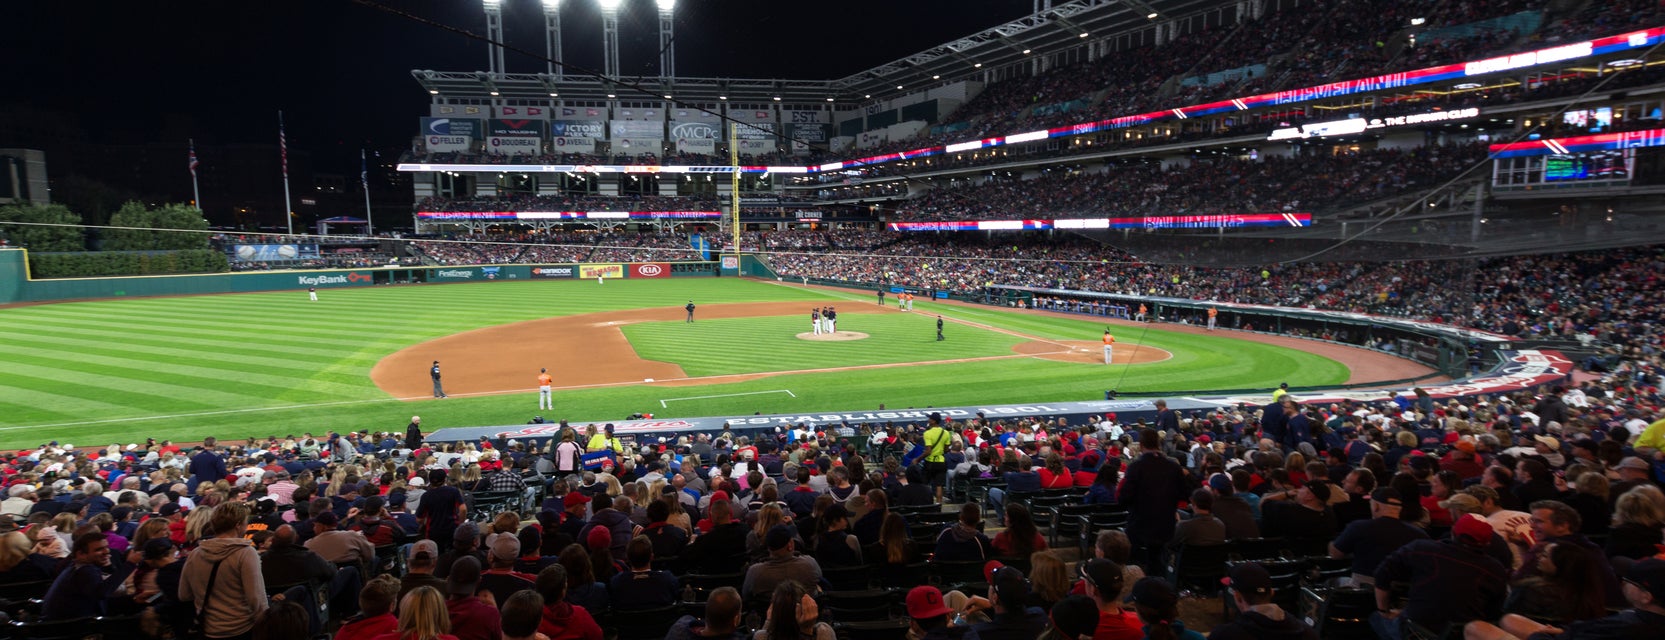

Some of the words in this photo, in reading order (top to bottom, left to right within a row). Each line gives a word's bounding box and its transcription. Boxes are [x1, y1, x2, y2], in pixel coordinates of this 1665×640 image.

[792, 112, 820, 123] EST.
[1385, 116, 1405, 126] THE
[1447, 107, 1479, 120] CLUB
[440, 137, 465, 145] FELLER
[501, 138, 536, 146] BOUDREAU
[566, 138, 592, 146] AVERILL
[642, 266, 657, 274] KIA
[298, 275, 347, 285] KeyBank
[927, 591, 938, 605] C
